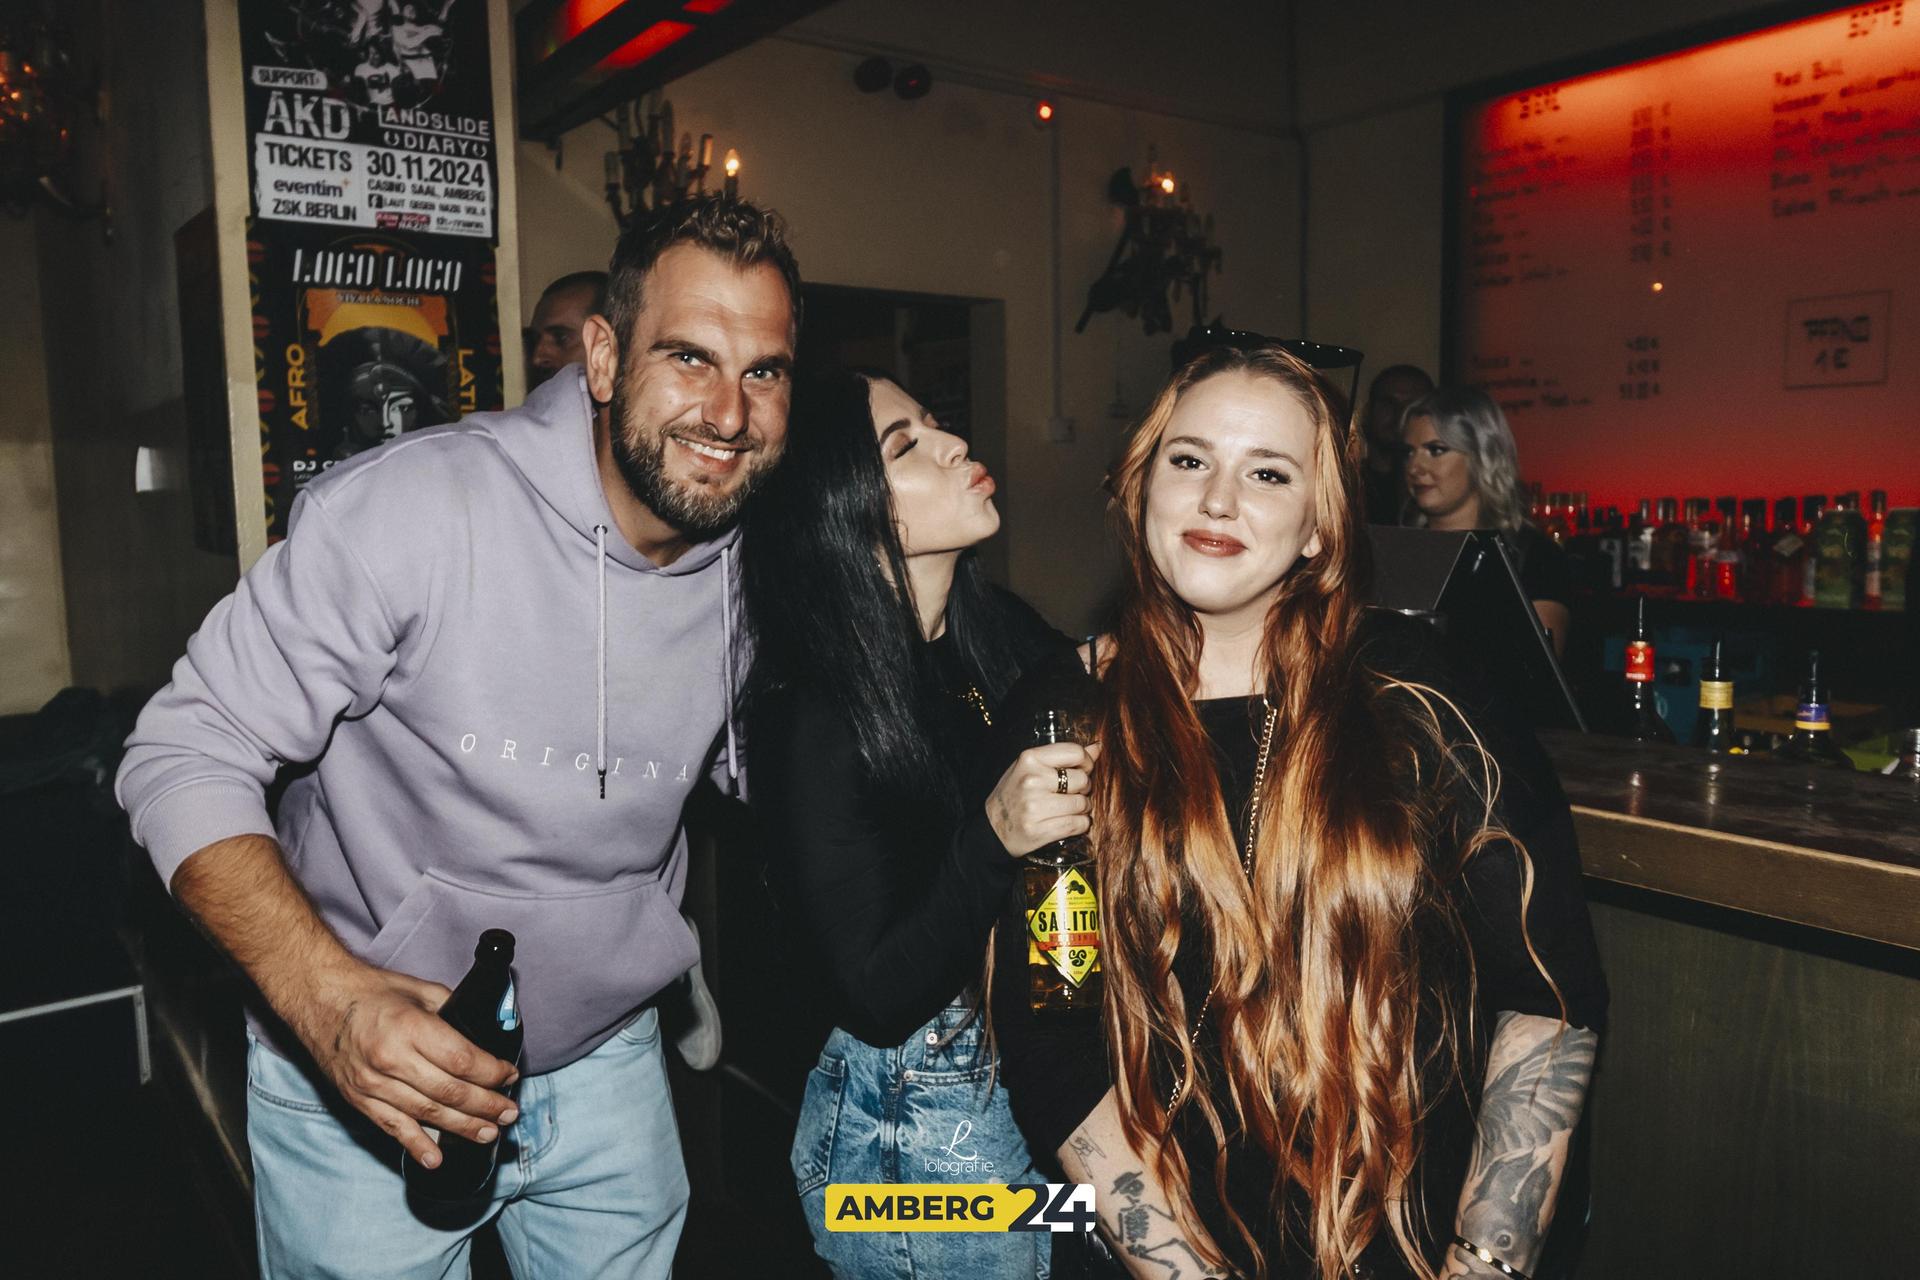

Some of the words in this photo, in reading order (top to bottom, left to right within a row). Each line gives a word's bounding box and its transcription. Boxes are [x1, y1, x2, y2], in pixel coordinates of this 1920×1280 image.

[264, 142, 352, 172] TICKETS
[403, 132, 469, 156] DIARY
[367, 150, 485, 188] 30.11.2024
[273, 179, 343, 198] eventim
[367, 178, 406, 194] CASINO
[292, 248, 376, 286] LOCO
[385, 255, 463, 292] LOCO
[286, 343, 309, 430] AFRO
[458, 349, 476, 416] LATI
[293, 460, 317, 472] DJ
[322, 460, 342, 471] C
[1038, 909, 1099, 933] SALITO
